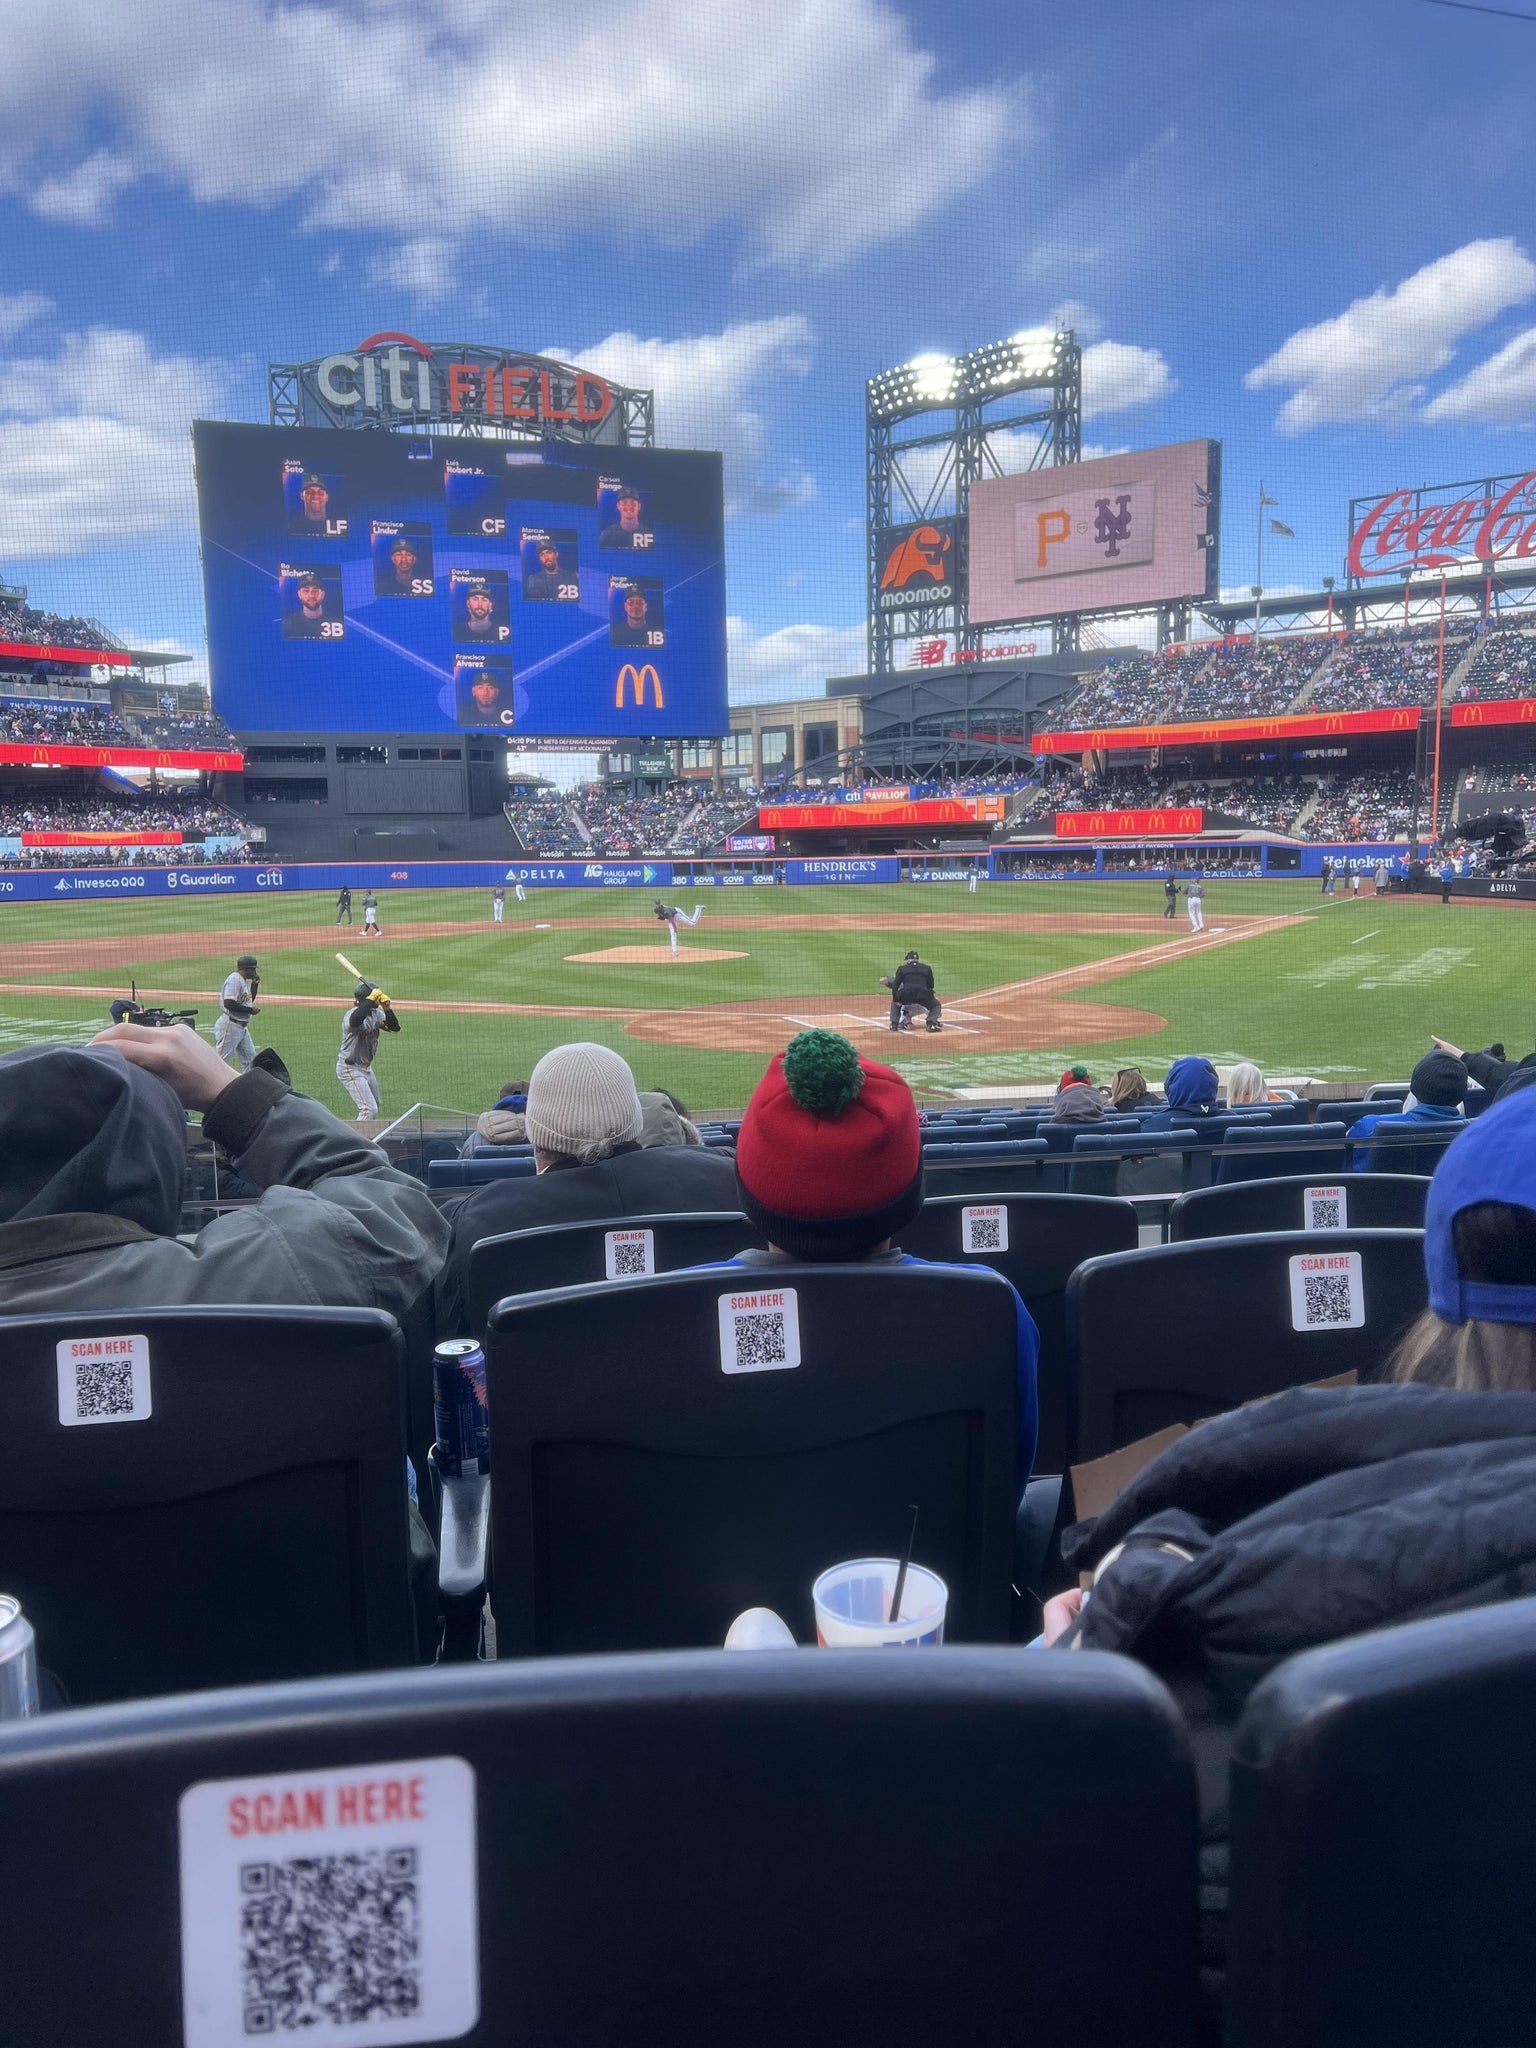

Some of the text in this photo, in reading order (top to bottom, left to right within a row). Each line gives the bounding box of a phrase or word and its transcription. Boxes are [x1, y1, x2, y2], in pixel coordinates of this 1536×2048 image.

[317, 345, 611, 421] citi FIELD
[446, 466, 472, 474] Robert
[599, 482, 622, 491] Benge
[326, 519, 348, 534] LF
[372, 520, 404, 528] Francisco
[482, 518, 505, 533] CF
[373, 527, 398, 535] Lindor
[633, 533, 654, 547] RF
[1037, 508, 1071, 569] P
[451, 575, 486, 583] Peterson
[411, 579, 433, 594] SS
[558, 584, 579, 599] 2B
[880, 585, 952, 607] moomoo
[320, 621, 344, 637] 3B
[498, 626, 510, 641] P
[647, 631, 664, 645] 1B
[951, 643, 1037, 663] new balance
[456, 660, 484, 668] Alvarez
[43, 704, 68, 712] PORCH
[500, 709, 514, 725] C
[845, 790, 907, 802] citi PAVILION
[539, 850, 564, 858] HubSpot
[571, 850, 596, 858] HubSpot
[606, 849, 630, 857] HubSpot
[642, 849, 666, 857] HubSpot
[671, 848, 695, 856] HubSpot
[804, 861, 877, 872] HENDRICK'S
[1323, 855, 1395, 869] Heineken
[180, 873, 235, 885] Guardian
[256, 871, 283, 885] citi
[390, 871, 408, 880] 408
[520, 869, 565, 879] DELTA
[752, 875, 774, 883] GOYA
[830, 873, 851, 881] GIN
[931, 871, 969, 880] DUNKIN'
[1203, 870, 1262, 878] CADILLAC
[75, 876, 145, 889] Invesco QQQ
[603, 877, 627, 885] GROUP
[672, 876, 687, 885] 380
[693, 876, 715, 884] GOYA
[1496, 884, 1517, 893] DELTA
[1311, 1188, 1340, 1197] SCAN HERE
[969, 1207, 1000, 1217] SCAN HERE
[612, 1232, 646, 1241] SCAN HERE
[1301, 1257, 1350, 1271] SCAN HERE
[731, 1293, 784, 1310] SCAN HERE
[71, 1340, 133, 1357] SCAN HERE
[228, 1776, 427, 1838] SCAN HERE
